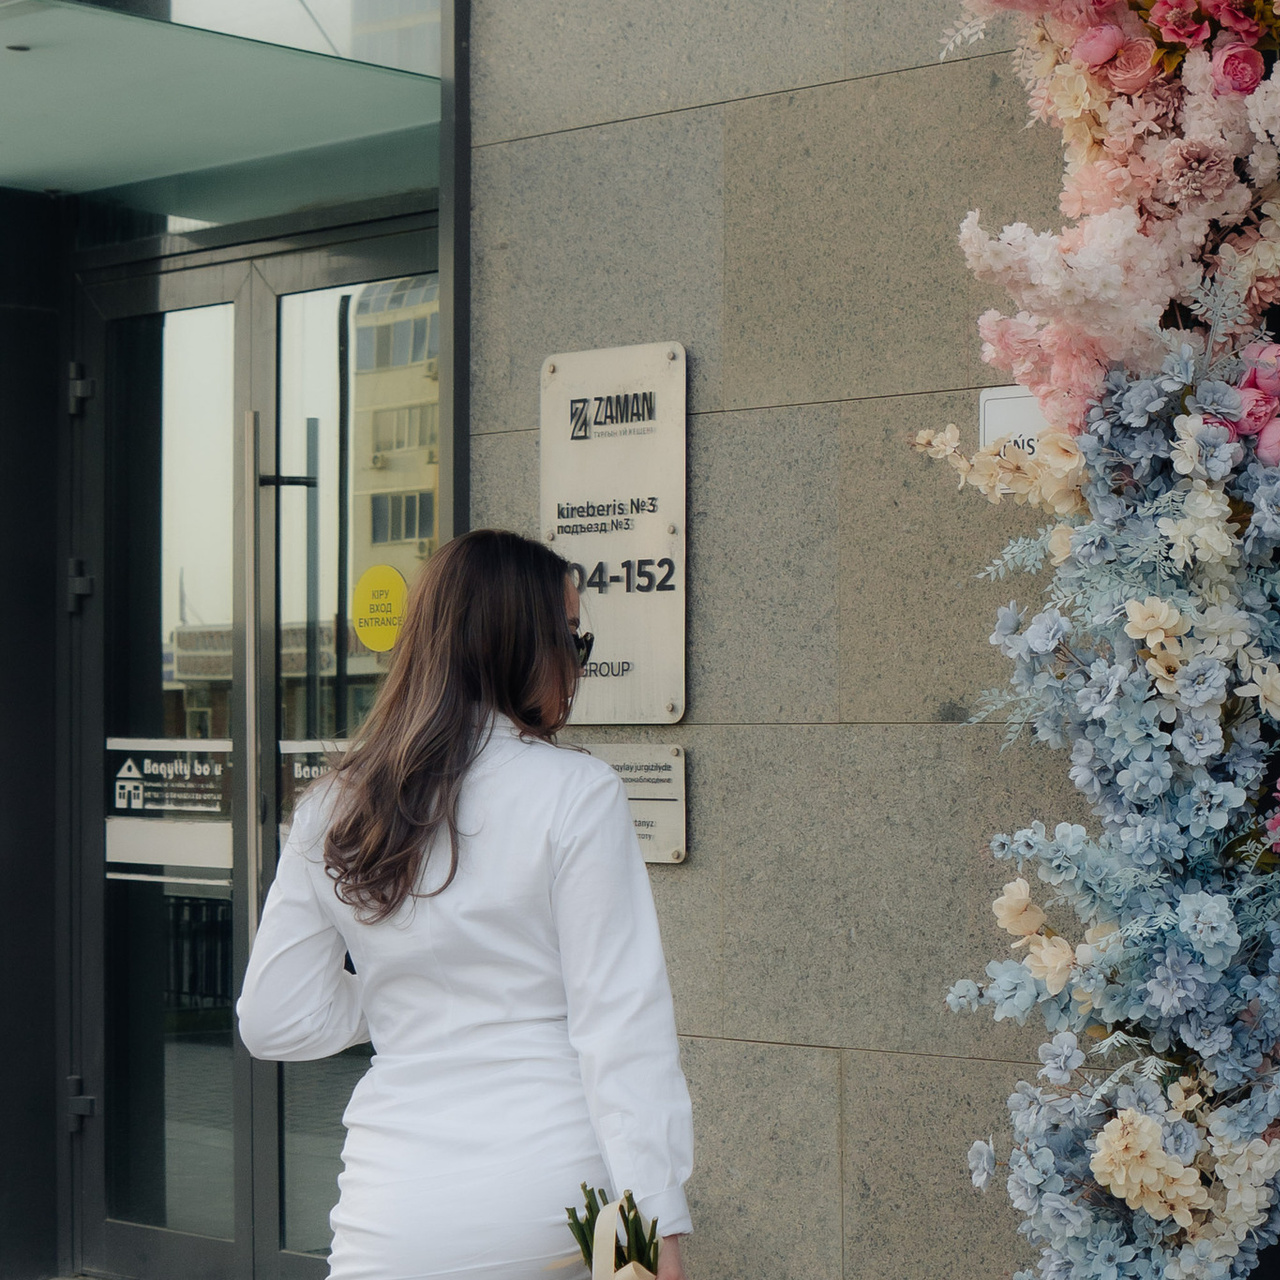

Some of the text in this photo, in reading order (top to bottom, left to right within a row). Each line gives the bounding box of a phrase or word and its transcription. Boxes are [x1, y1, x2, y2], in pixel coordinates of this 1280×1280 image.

[593, 391, 655, 425] ZAMAN
[557, 497, 658, 519] kireberis №3
[557, 518, 631, 535] подъезд №3
[369, 602, 392, 614] ВХОД
[358, 616, 403, 628] ENTRANCE
[194, 759, 223, 776] bou
